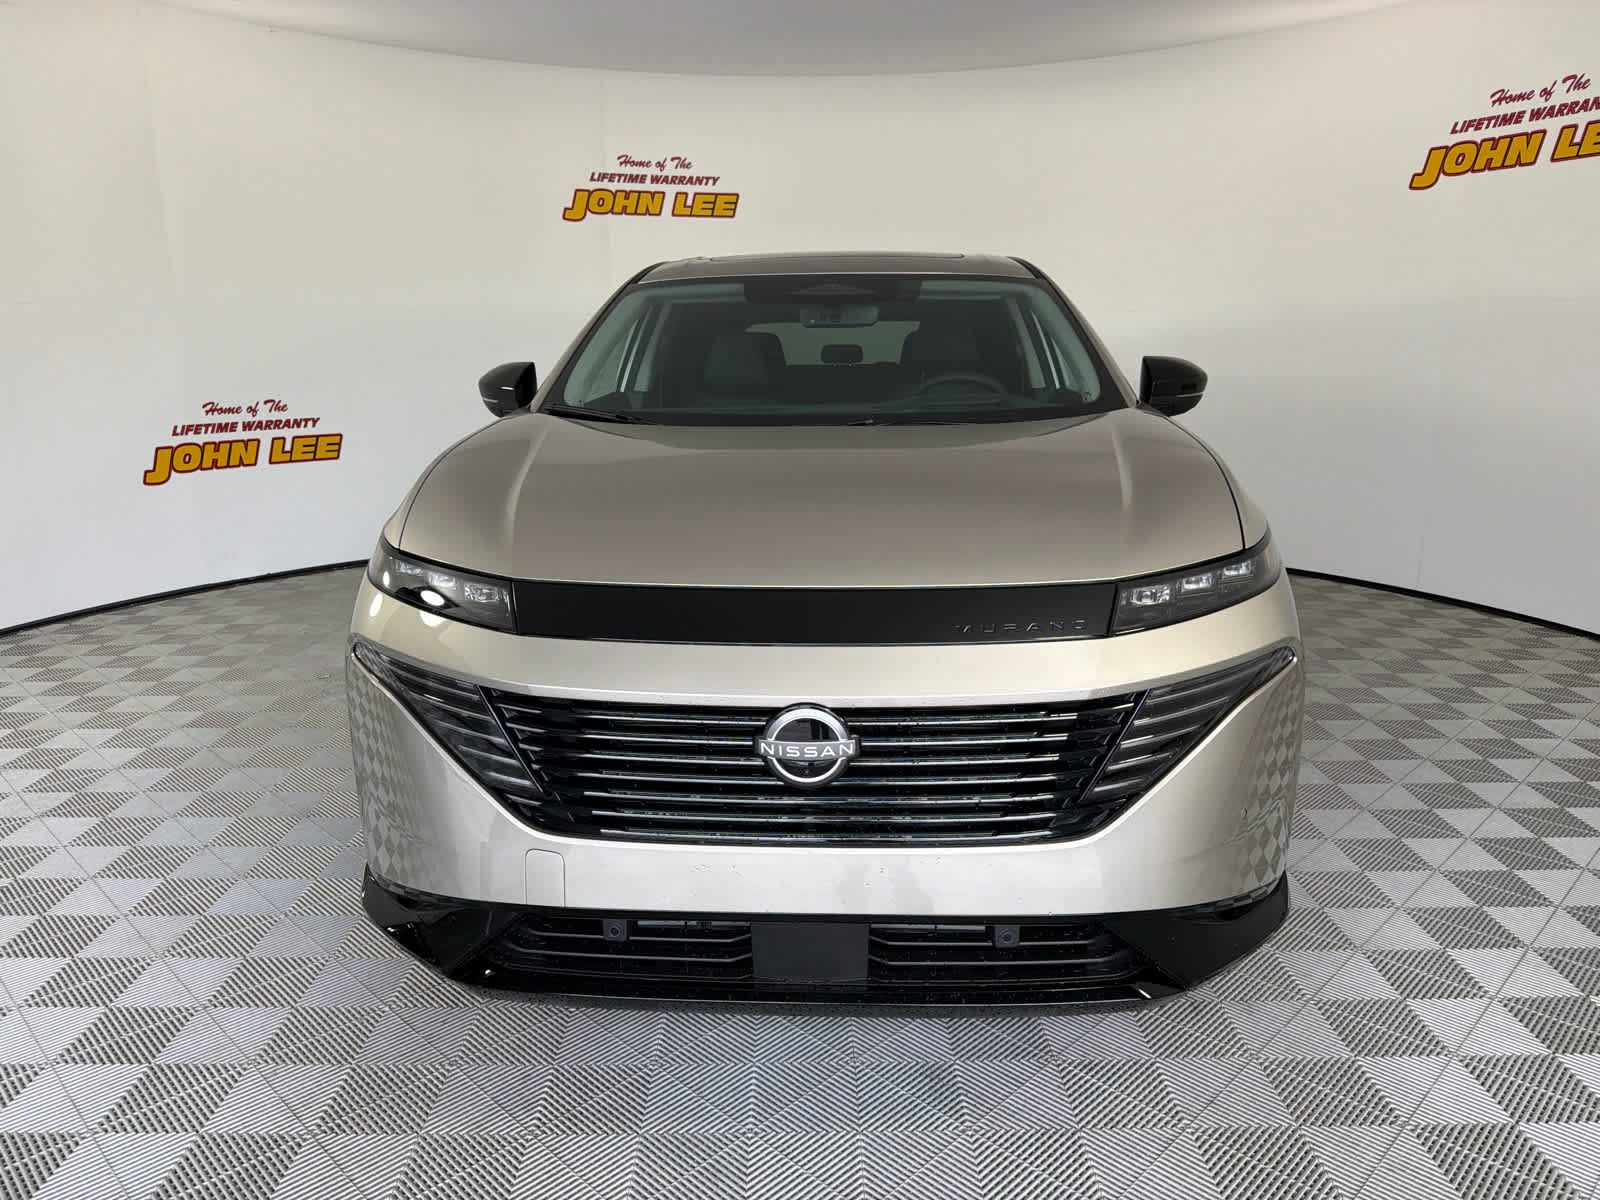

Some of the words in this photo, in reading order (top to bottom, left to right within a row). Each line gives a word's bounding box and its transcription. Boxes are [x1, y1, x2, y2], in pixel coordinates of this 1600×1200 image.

[1490, 88, 1535, 107] Home
[1539, 80, 1557, 101] of
[1562, 73, 1591, 93] The
[1450, 110, 1527, 134] LIFETIME
[617, 154, 652, 169] Home
[655, 157, 667, 172] of
[670, 156, 693, 170] The
[1409, 129, 1547, 190] JOHN
[590, 172, 647, 184] LIFETIME
[650, 175, 720, 186] WARRANTY
[562, 188, 665, 222] JOHN
[672, 191, 739, 218] LEE
[202, 401, 243, 416] Home
[246, 401, 259, 417] of
[263, 399, 288, 413] The
[172, 421, 238, 436] LIFETIME
[242, 417, 320, 432] WARRANTY
[143, 438, 260, 485] JOHN
[269, 433, 343, 464] LEE
[952, 615, 1088, 633] MURANO
[760, 742, 853, 757] NISSAN
